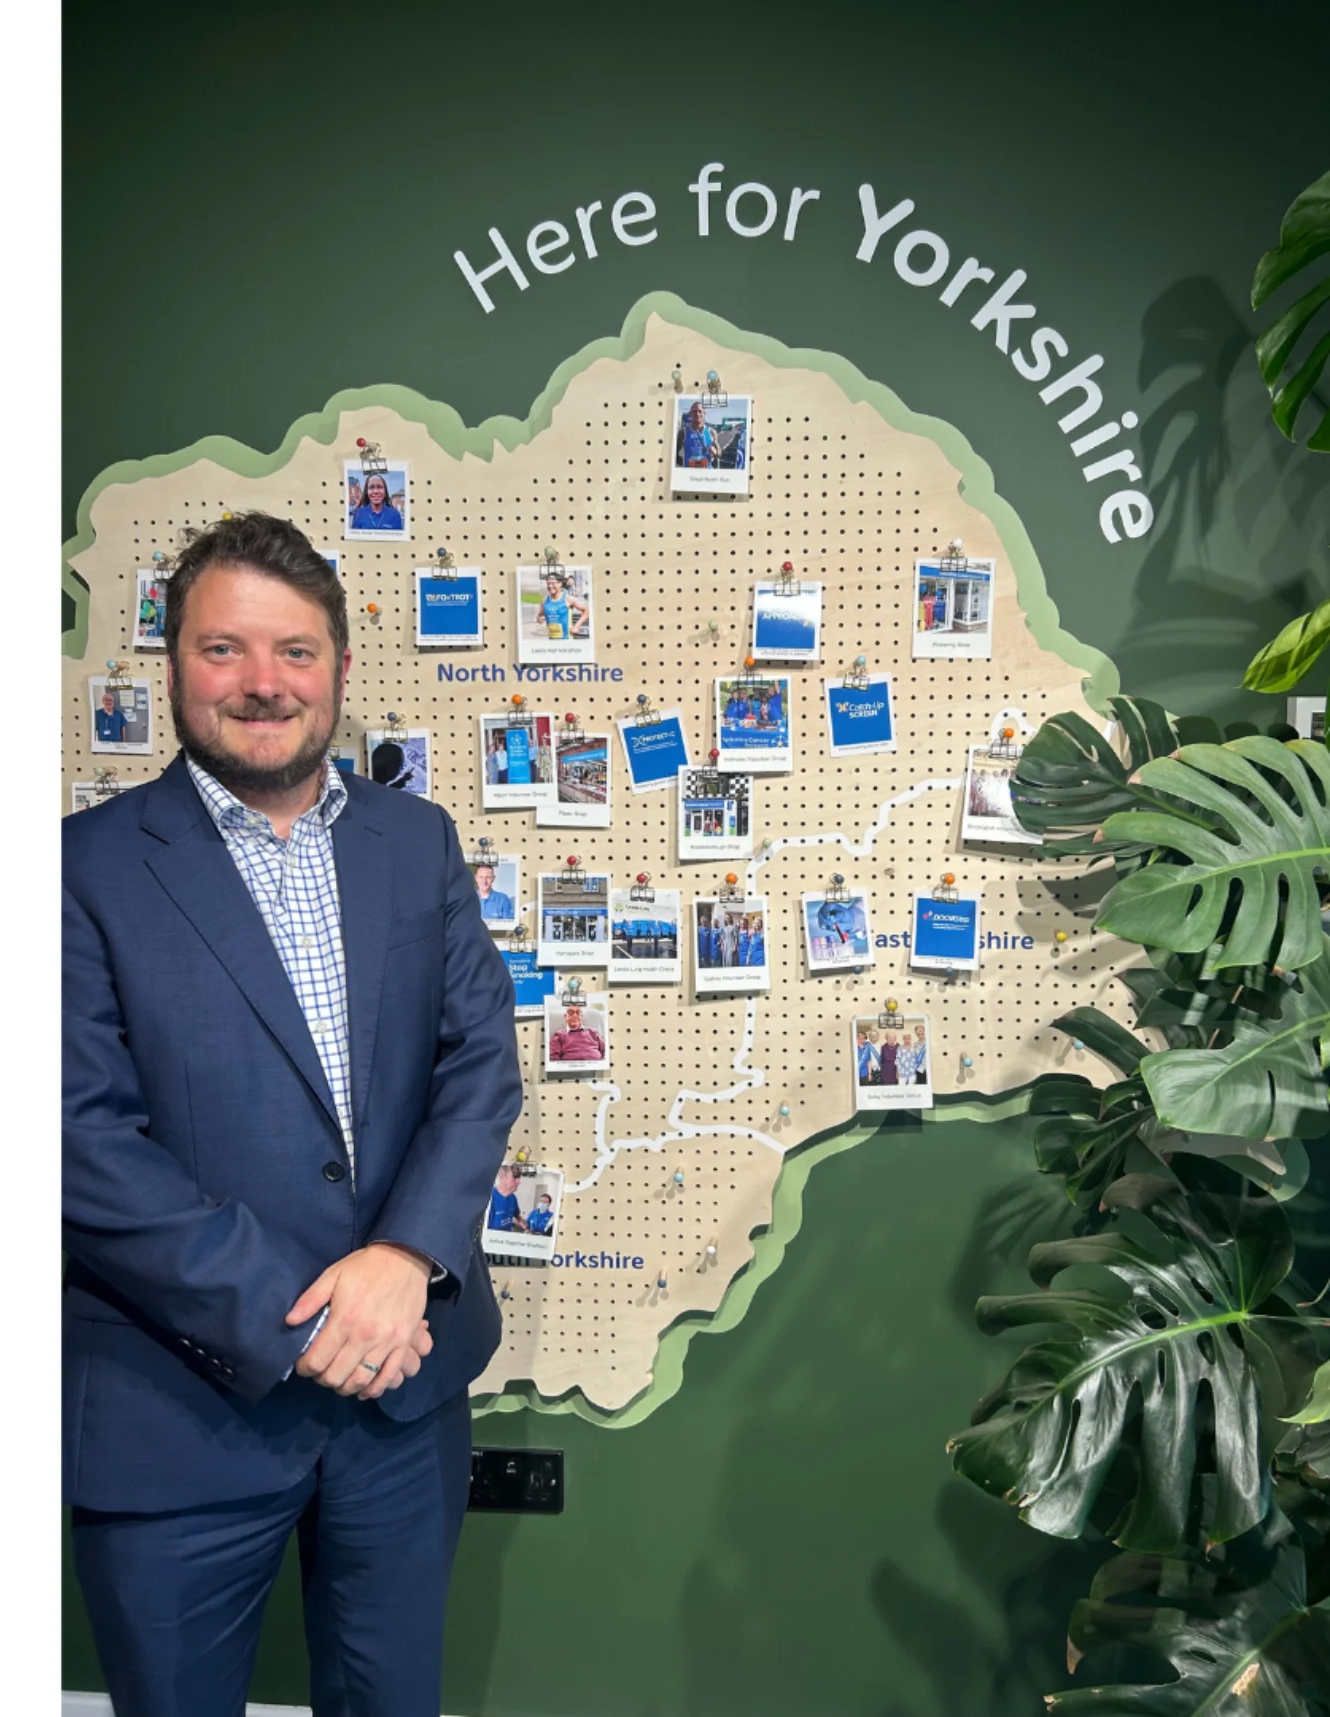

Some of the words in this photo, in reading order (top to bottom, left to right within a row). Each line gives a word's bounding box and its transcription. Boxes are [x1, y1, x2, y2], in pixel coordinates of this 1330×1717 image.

[454, 190, 658, 313] Here
[688, 162, 821, 241] for
[855, 184, 1155, 544] Yorkshire
[437, 663, 505, 683] North
[513, 663, 623, 683] Yorkshire
[875, 931, 911, 948] ast
[978, 931, 1034, 950] shire
